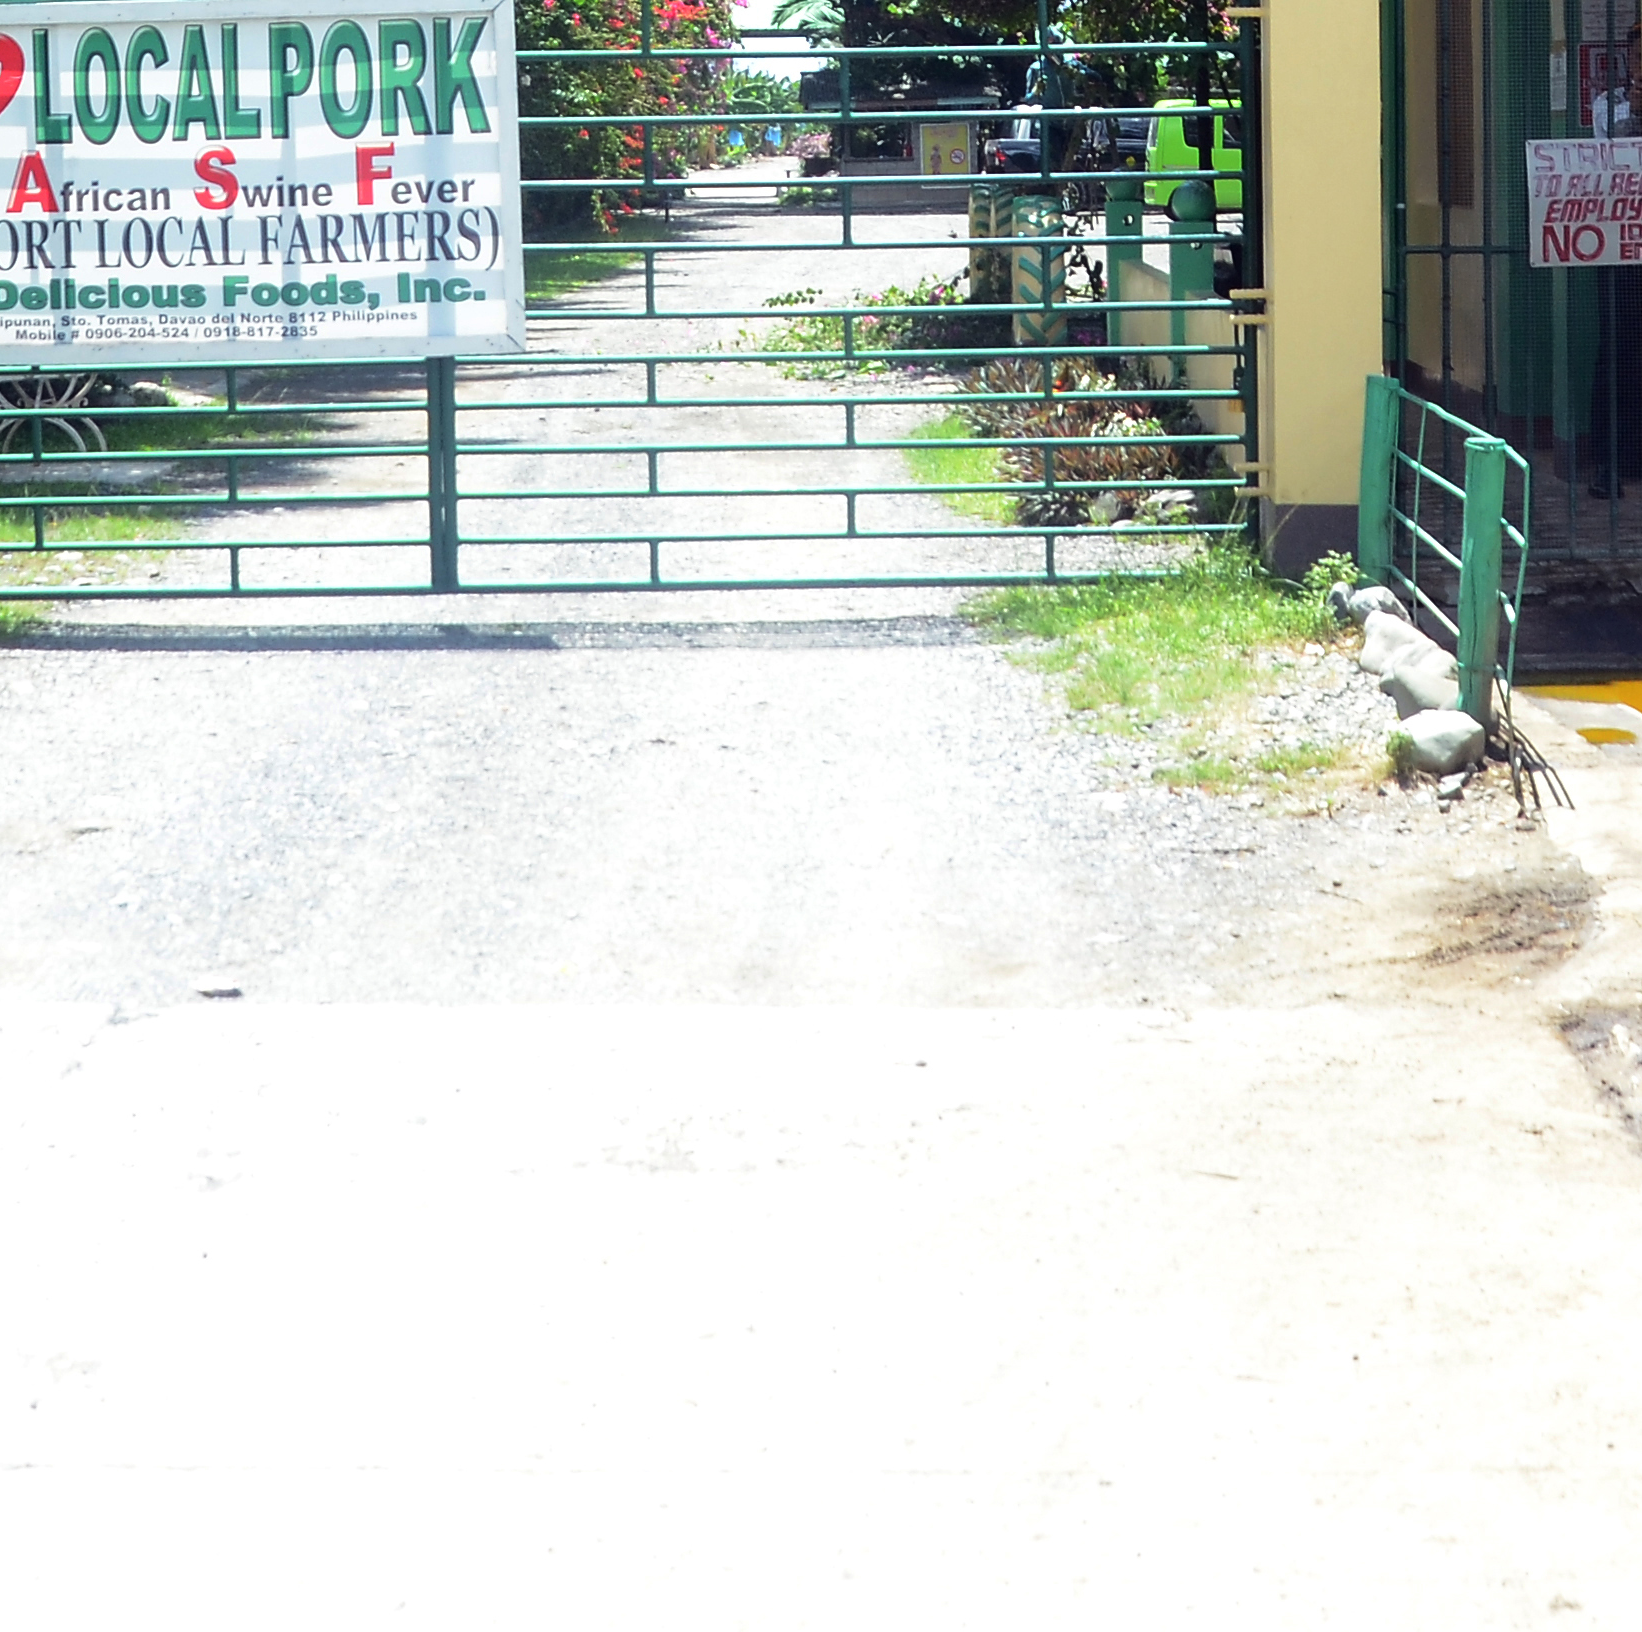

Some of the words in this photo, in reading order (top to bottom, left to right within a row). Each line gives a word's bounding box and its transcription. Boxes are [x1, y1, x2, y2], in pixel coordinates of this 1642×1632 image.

[6, 149, 170, 214] African
[193, 144, 333, 210] Swine
[355, 141, 475, 207] Fever
[1533, 174, 1562, 197] TO
[1567, 173, 1604, 197] ALL
[93, 213, 246, 270] LOCAL
[259, 205, 500, 272] FARMERS)
[1542, 224, 1605, 262] NO
[223, 273, 380, 311] Foods,
[397, 272, 486, 303] Inc.
[15, 329, 66, 341] Mobile
[85, 327, 189, 339] 0906-204-524
[204, 325, 318, 338] 0918-817-2835
[61, 315, 90, 327] Sto.
[98, 314, 152, 327] Tomas,
[158, 313, 205, 325] Davao
[211, 313, 235, 324] del
[241, 312, 284, 324] Norte
[289, 311, 326, 323] 8112
[332, 309, 418, 323] Philippines
